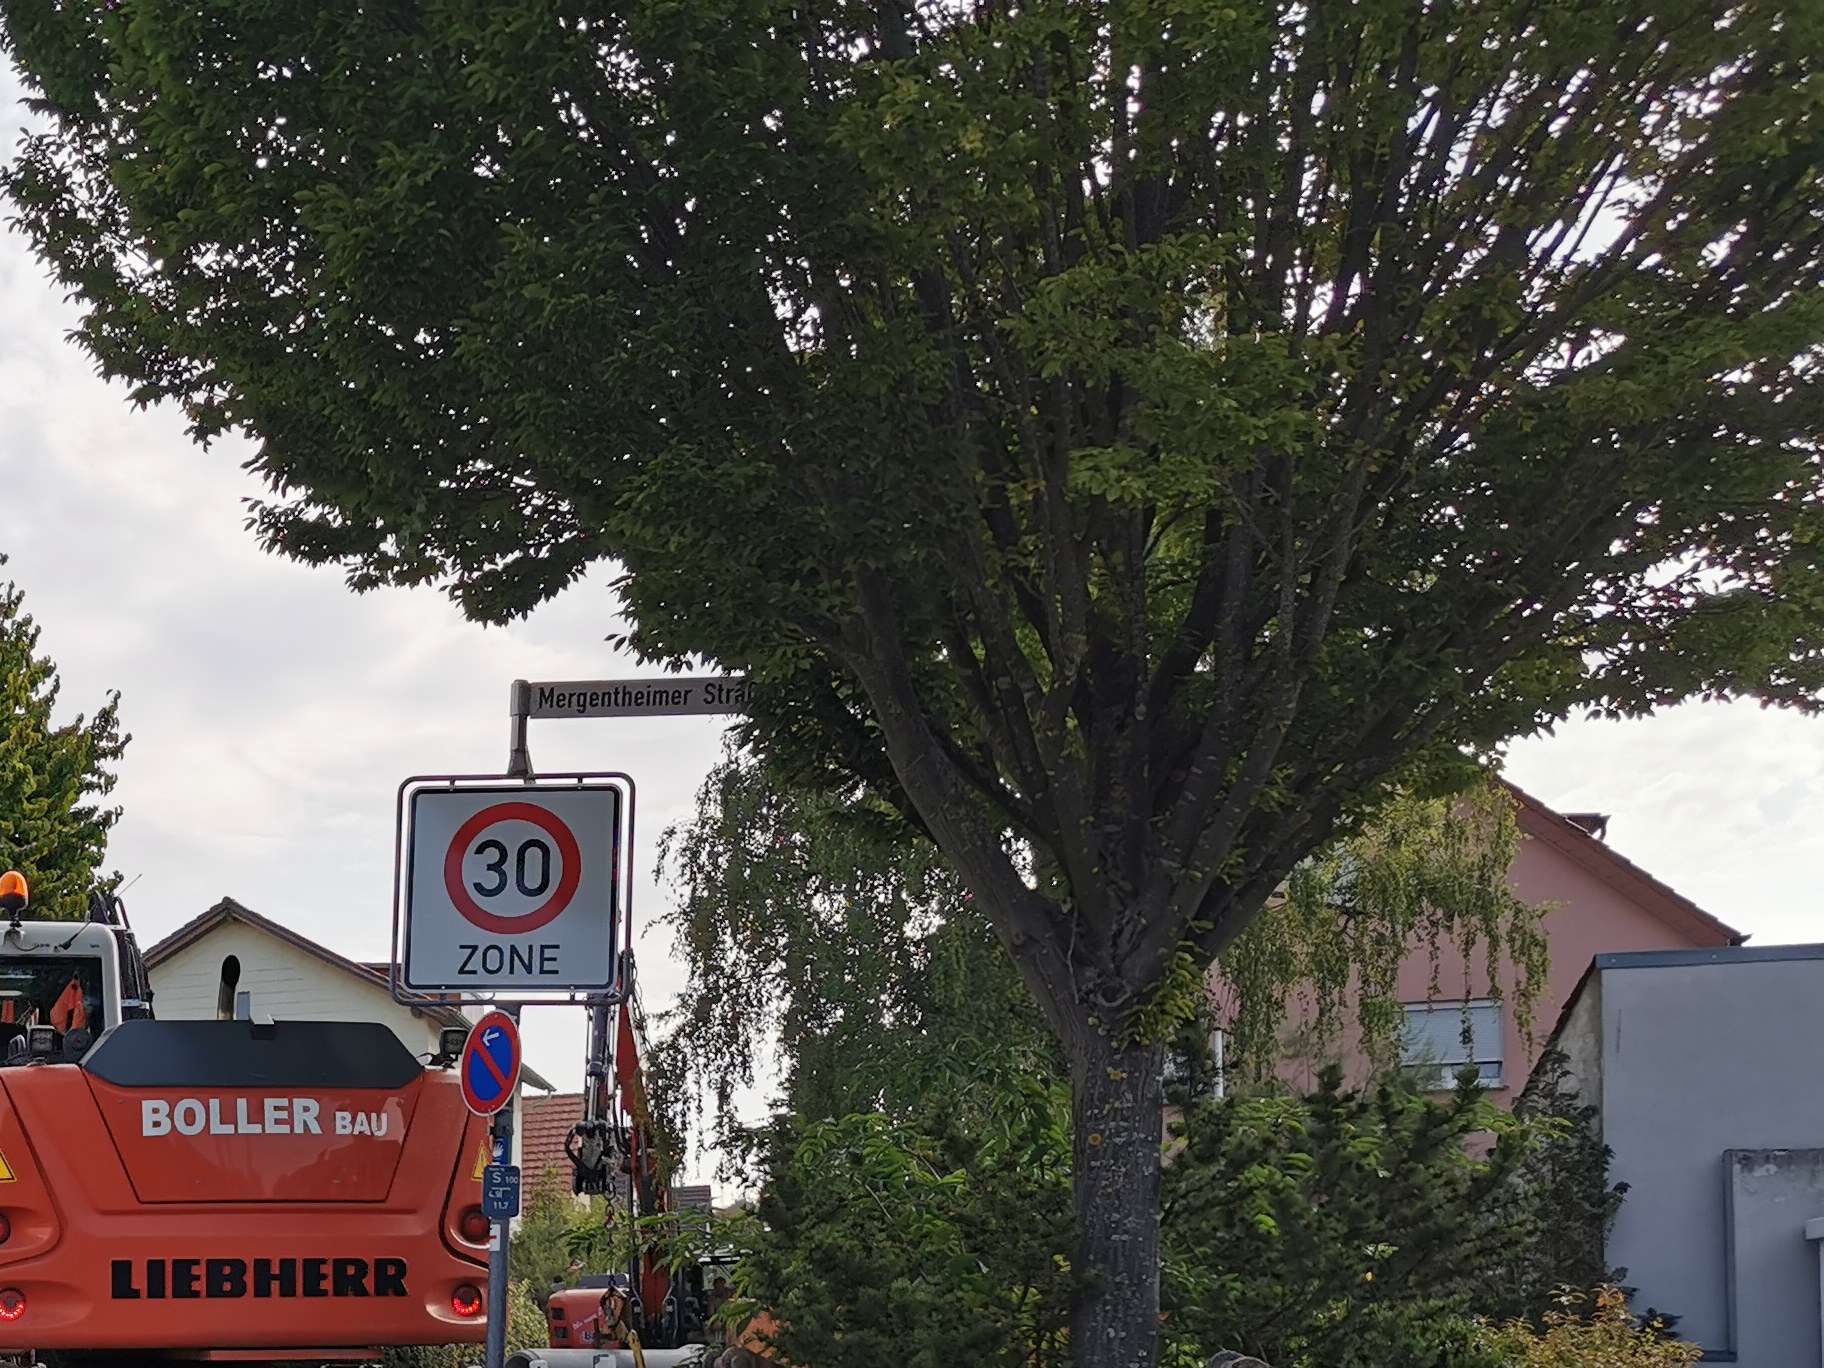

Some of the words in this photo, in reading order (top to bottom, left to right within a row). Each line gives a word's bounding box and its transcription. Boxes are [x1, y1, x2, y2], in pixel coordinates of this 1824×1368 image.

[537, 684, 693, 714] Mergentheimer
[472, 838, 551, 898] 30
[458, 944, 561, 976] ZONE
[141, 1098, 323, 1137] BOLLER
[335, 1111, 388, 1136] BAU
[111, 1258, 410, 1299] LIEBHERR
